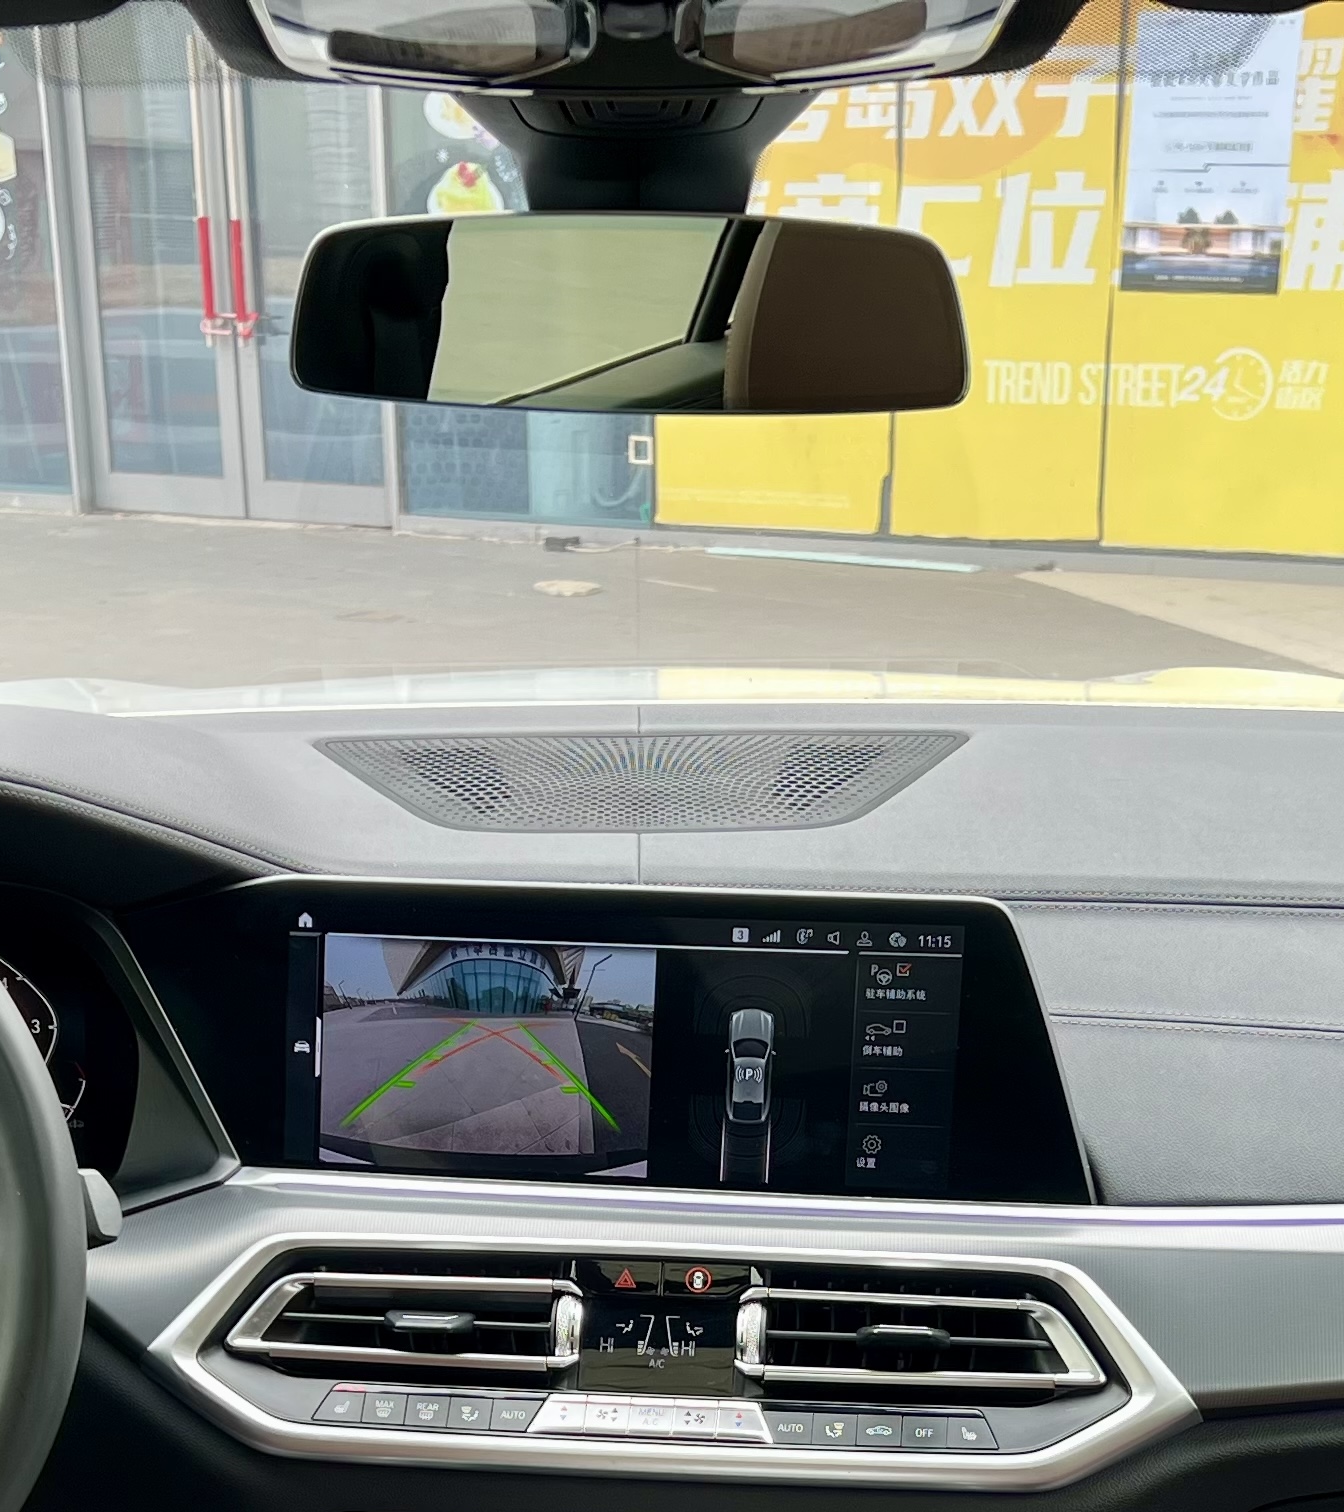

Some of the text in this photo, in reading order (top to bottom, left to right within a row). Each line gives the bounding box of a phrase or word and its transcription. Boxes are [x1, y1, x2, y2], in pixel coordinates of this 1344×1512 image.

[983, 358, 1072, 406] TREND
[918, 934, 952, 948] 11:15
[865, 988, 927, 1001] 驻车辅助系统
[31, 1018, 41, 1034] 3
[862, 1045, 904, 1058] 倒车辅助
[858, 1101, 911, 1114] 摄像头图像
[856, 1157, 877, 1169] 设置
[599, 1336, 696, 1357] HI HI
[648, 1358, 666, 1369] A/C
[375, 1399, 395, 1409] MAX
[416, 1402, 440, 1411] REAR
[499, 1409, 526, 1420] AUTO
[777, 1423, 804, 1433] AUTO
[914, 1428, 934, 1438] OFF
